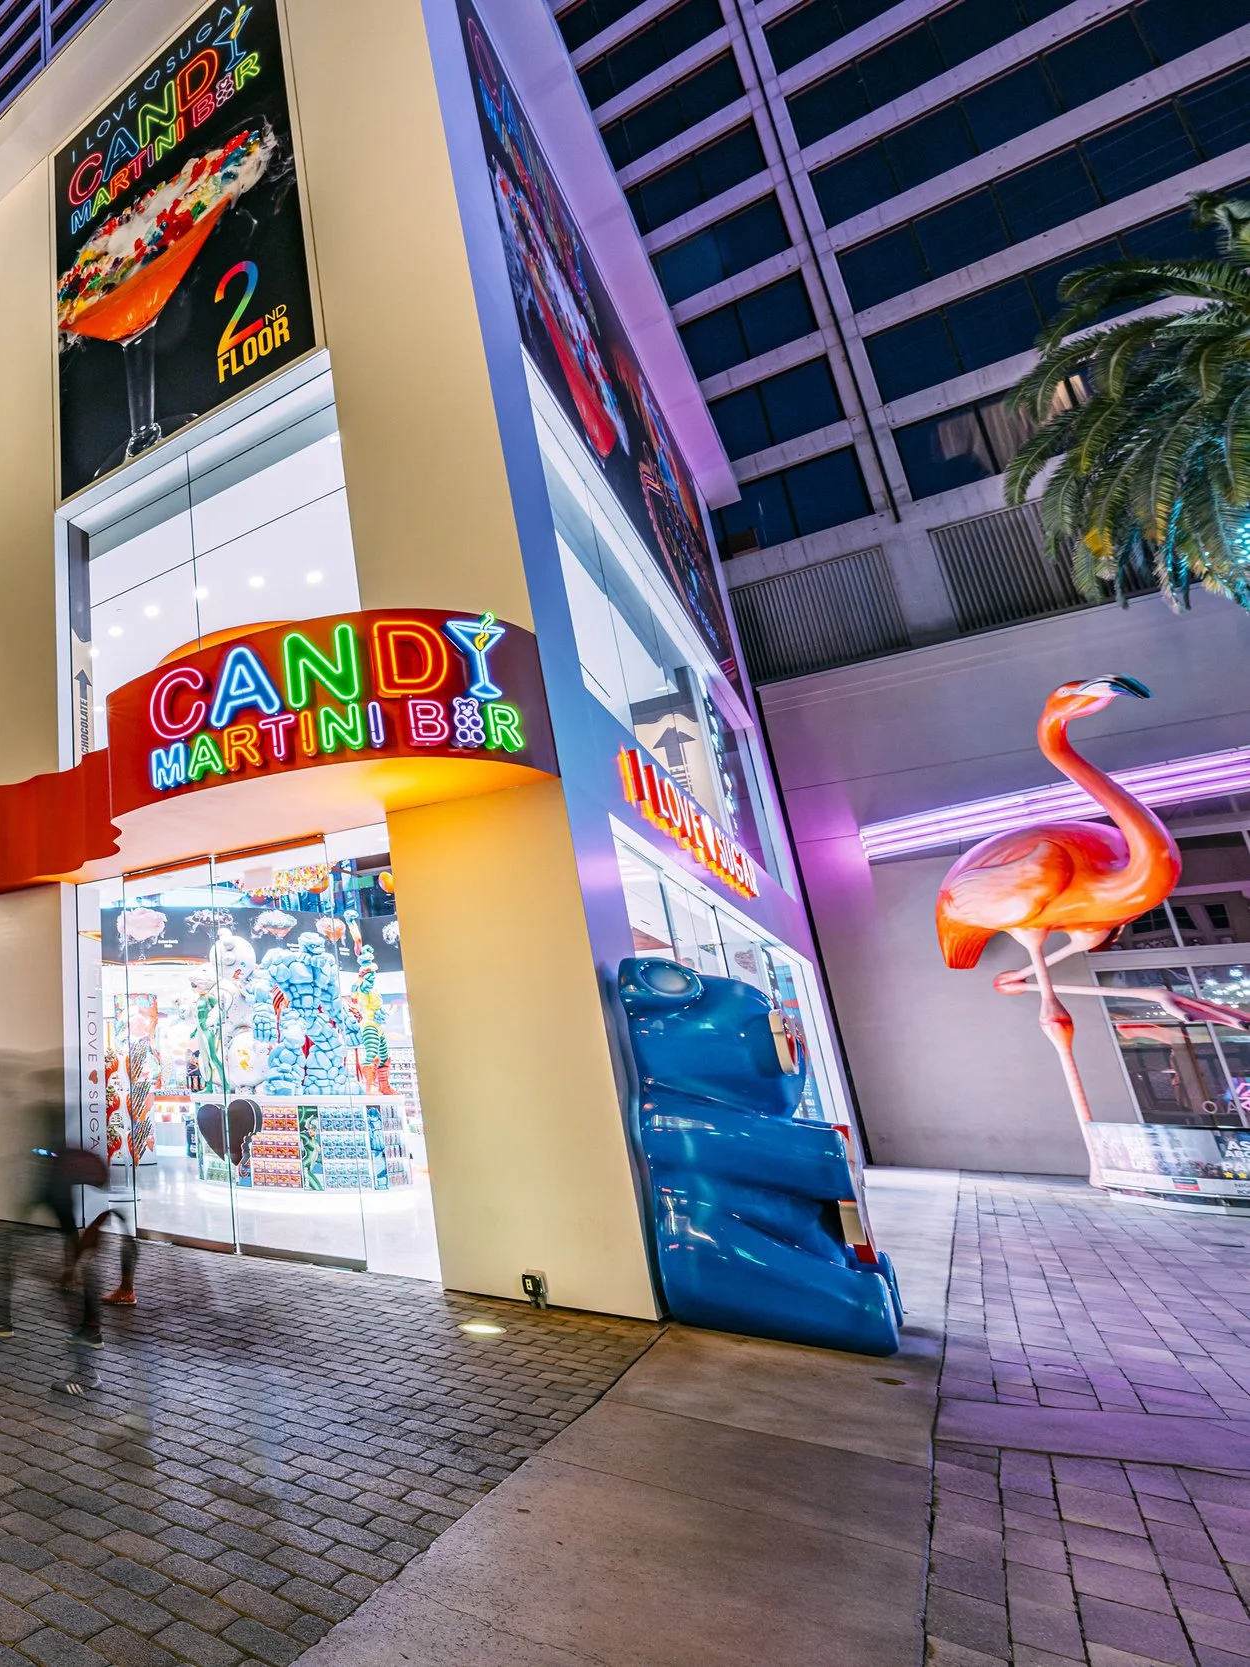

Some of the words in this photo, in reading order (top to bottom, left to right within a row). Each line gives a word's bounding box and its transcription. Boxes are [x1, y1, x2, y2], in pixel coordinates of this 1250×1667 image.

[68, 5, 253, 205] CANDY
[86, 91, 138, 150] LOVE
[166, 0, 240, 73] SUGA
[71, 117, 185, 235] MARTINI
[217, 316, 290, 383] FLOOR
[149, 612, 506, 740] CANDY
[150, 700, 386, 791] MARTINI
[645, 764, 705, 849] LOVE
[713, 826, 761, 898] SUGAR
[87, 1010, 98, 1063] LOVE
[88, 1090, 100, 1157] SUGA
